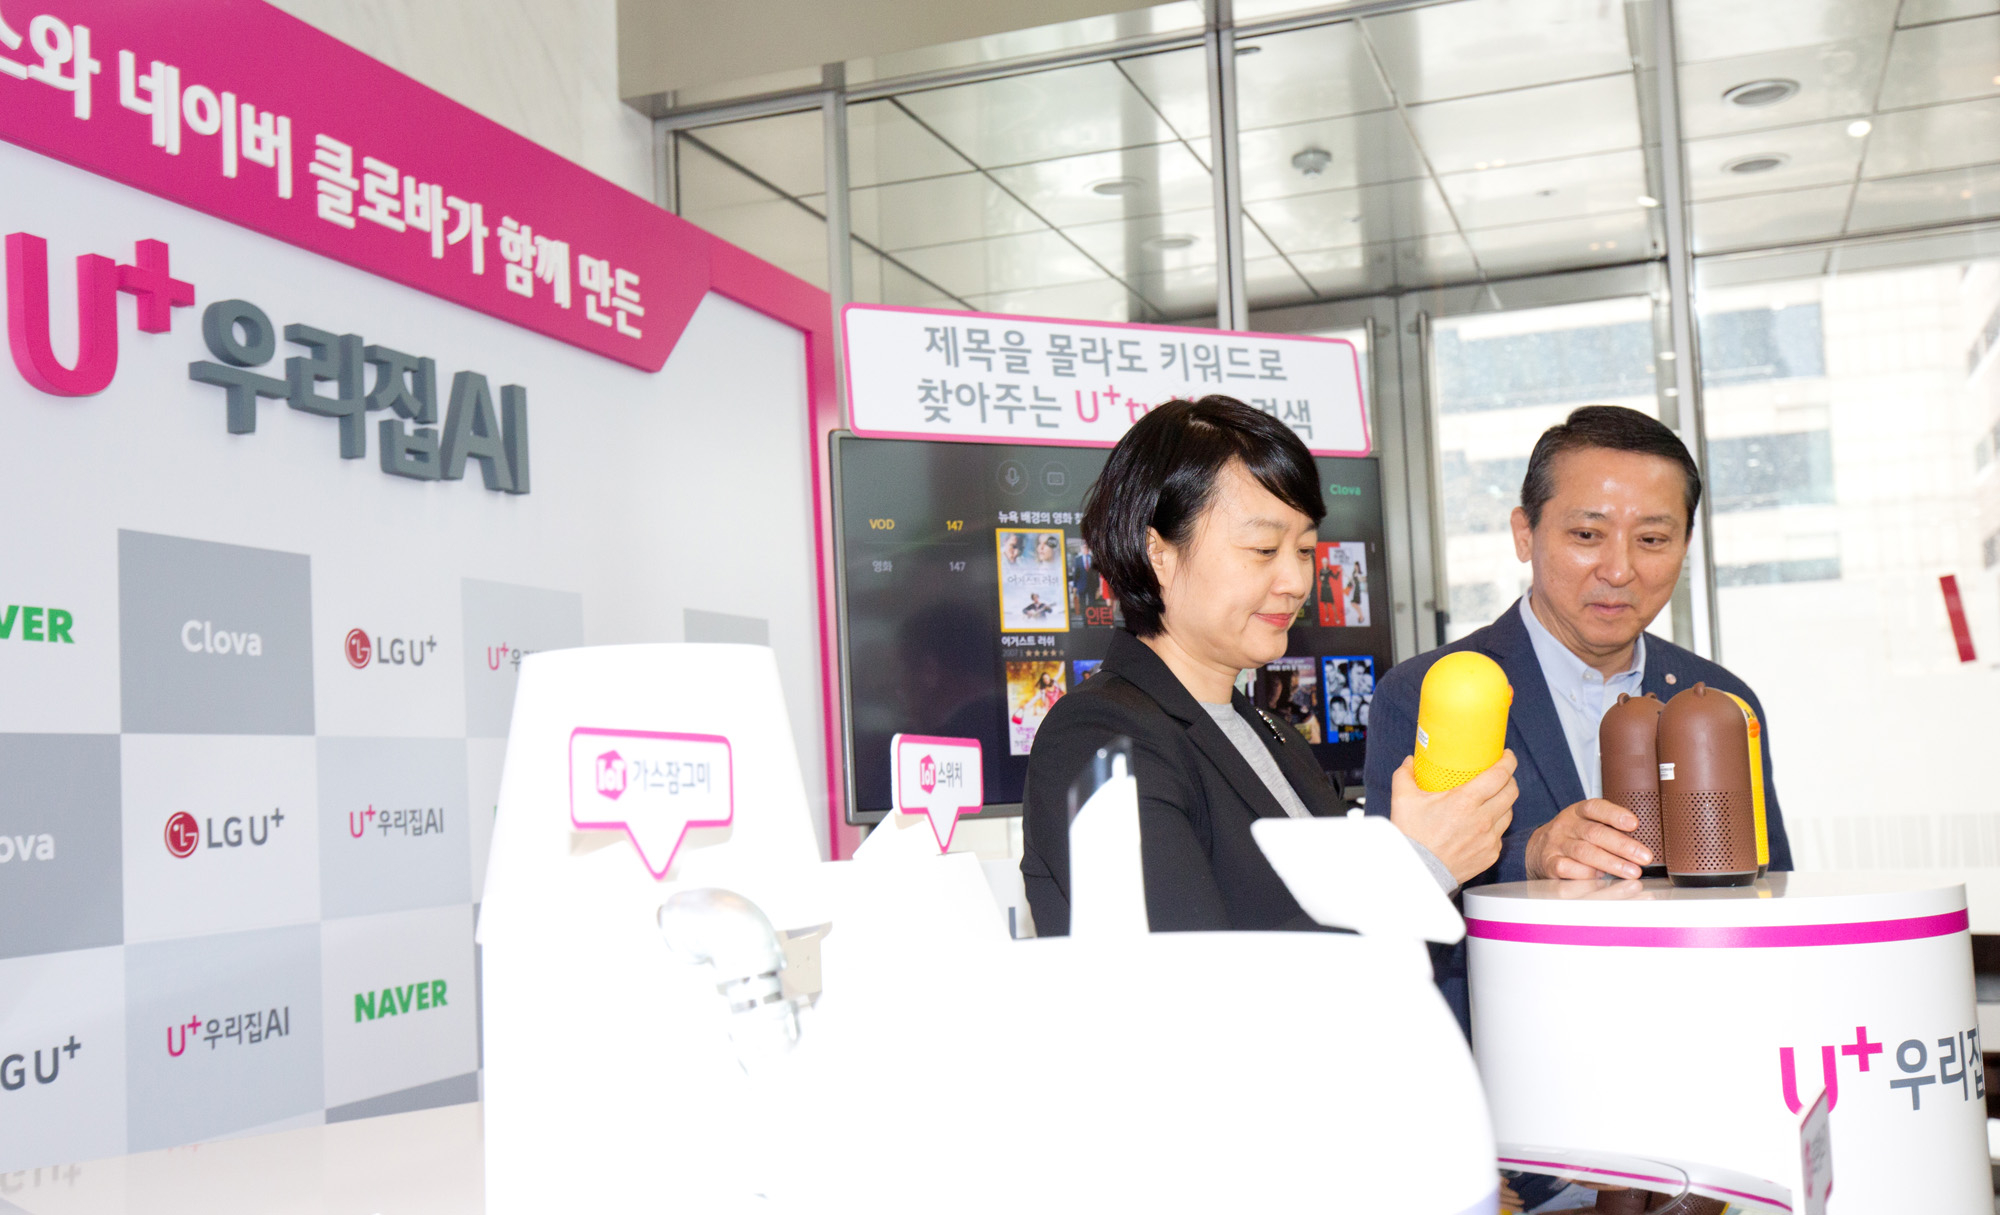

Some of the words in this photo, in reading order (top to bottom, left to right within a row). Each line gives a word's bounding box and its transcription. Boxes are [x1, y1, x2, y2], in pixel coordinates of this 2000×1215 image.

[119, 50, 292, 200] 네이버
[309, 134, 488, 275] 클로바가
[497, 216, 570, 309] 함께
[578, 253, 645, 339] 만든
[924, 325, 1032, 376] 제목을
[1045, 332, 1148, 379] 몰라도
[1160, 341, 1288, 384] 키워드로
[917, 378, 1062, 429] 찾아주는
[1329, 484, 1362, 496] Clova
[869, 518, 896, 530] VOD
[946, 520, 964, 531] 147
[998, 511, 1019, 524] 뉴욕
[1020, 511, 1051, 525] 배경의
[1052, 511, 1073, 525] 영화
[872, 560, 893, 573] 영화
[949, 561, 966, 572] 147
[1085, 606, 1114, 626] 인턴
[181, 620, 262, 657] Clova
[1001, 635, 1036, 647] 어거스트
[597, 759, 625, 791] IoT
[632, 760, 712, 796] 가스잠그미
[937, 761, 963, 789] 스위치
[354, 979, 448, 1023] NAVER
